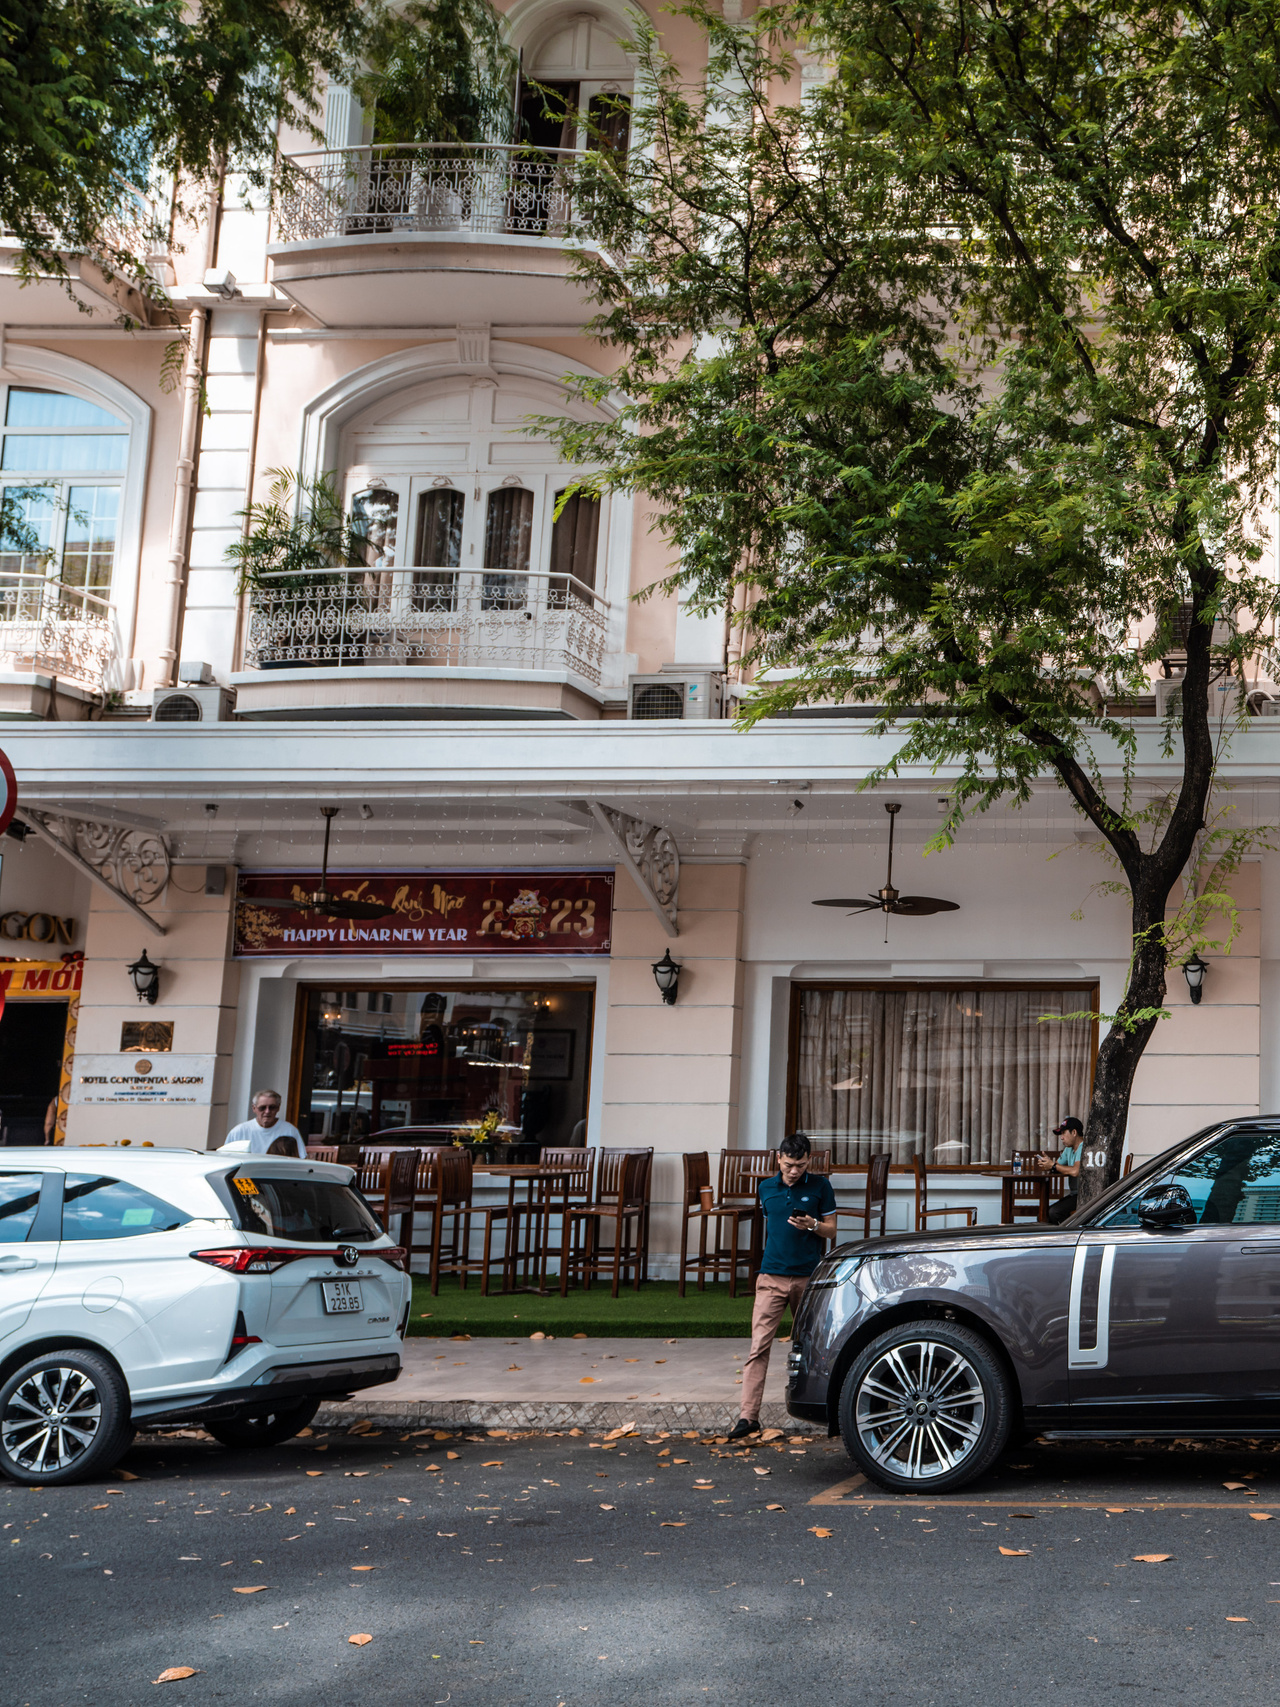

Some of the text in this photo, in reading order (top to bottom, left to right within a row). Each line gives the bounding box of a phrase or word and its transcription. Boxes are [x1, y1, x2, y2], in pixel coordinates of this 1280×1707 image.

[283, 928, 468, 942] HAPPY LUNAR NEW YEAR
[80, 1076, 204, 1084] HOTEL CONTINENTAL SAIGON
[1086, 1150, 1107, 1168] 10
[334, 1283, 352, 1296] 51K
[330, 1297, 360, 1311] 229.85
